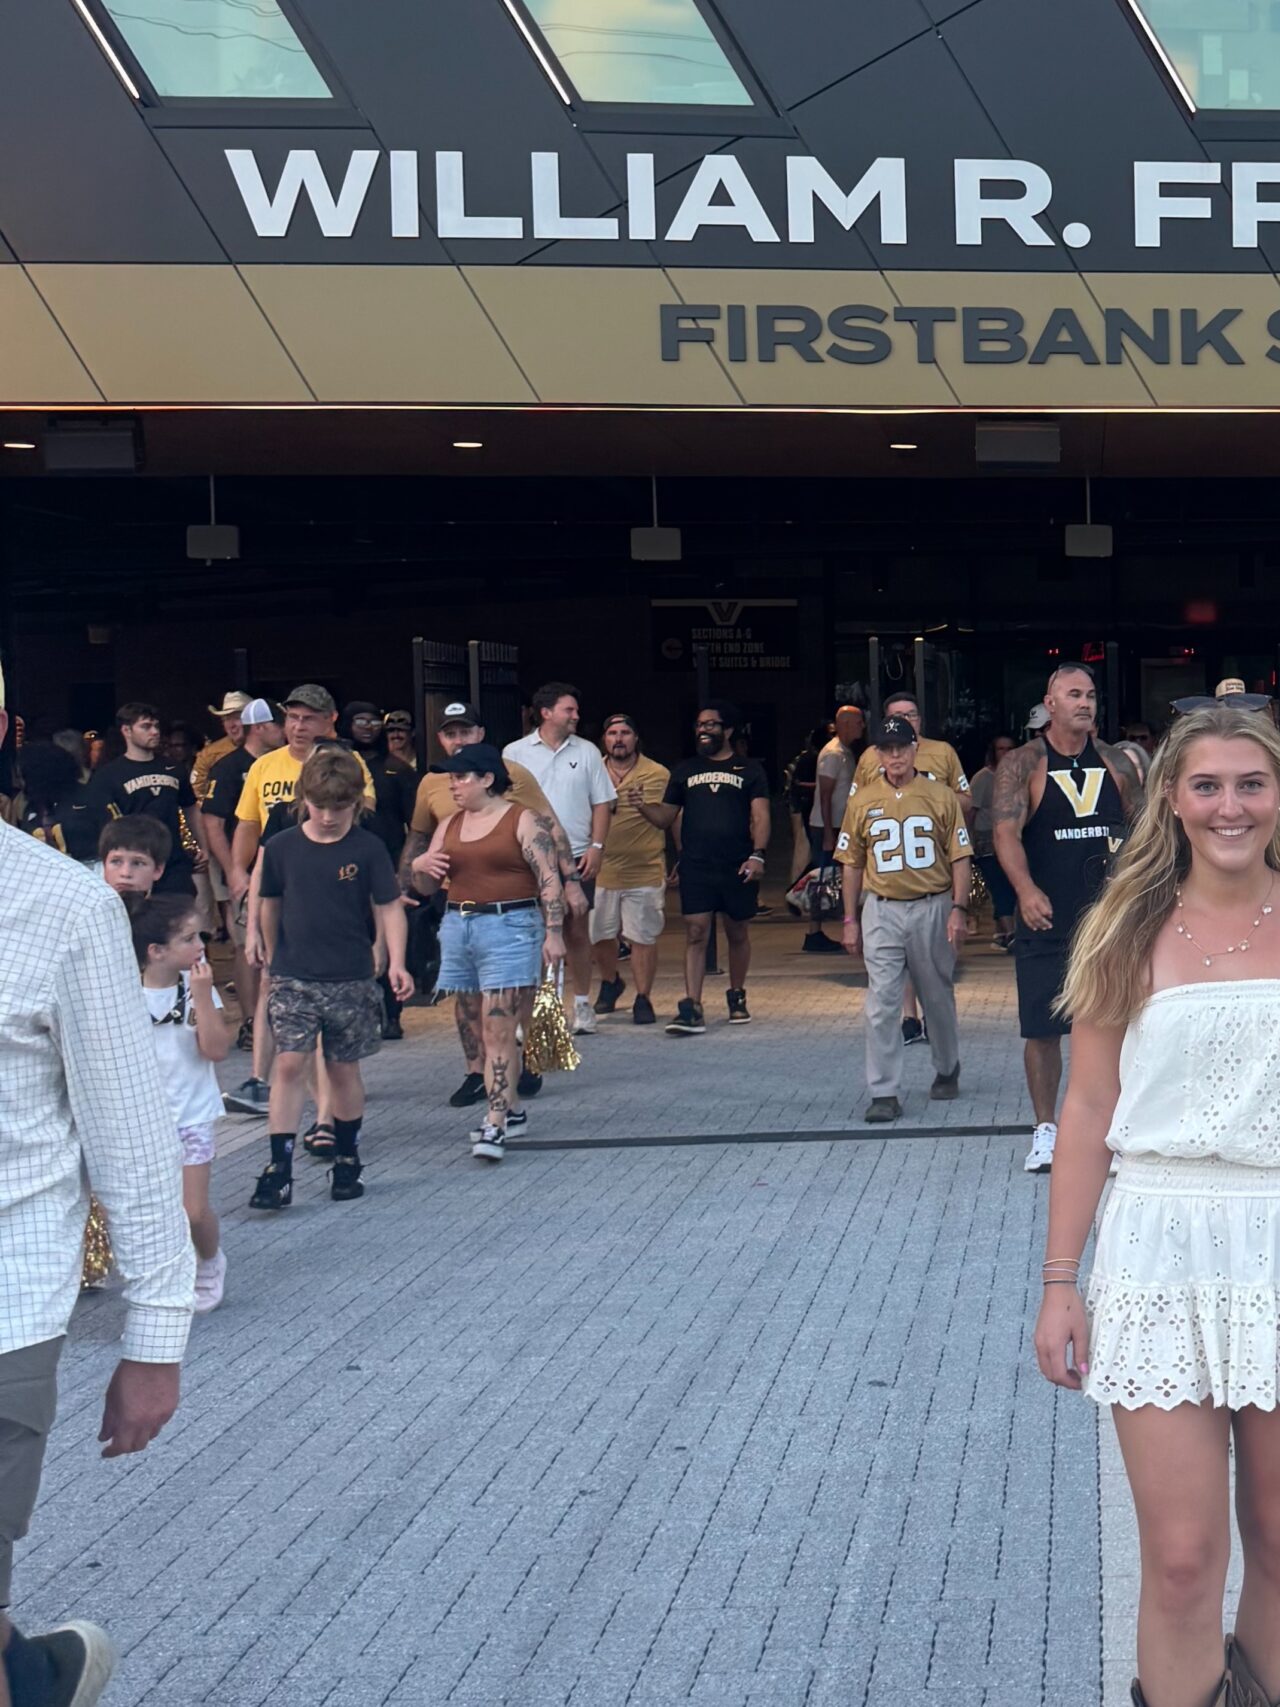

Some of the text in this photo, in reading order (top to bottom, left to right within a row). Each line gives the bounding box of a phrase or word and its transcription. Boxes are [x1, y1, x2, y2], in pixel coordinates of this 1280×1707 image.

[223, 148, 908, 245] WILLIAM
[953, 158, 1092, 248] R.
[659, 303, 1243, 366] FIRSTBANK
[690, 627, 735, 640] SECTIONS
[691, 641, 722, 654] NTH
[742, 641, 765, 654] ZONE
[263, 780, 294, 798] CON
[687, 771, 744, 789] VANDERBILT
[1048, 767, 1107, 818] V
[1054, 825, 1110, 841] VANDERBI
[869, 814, 937, 873] 26
